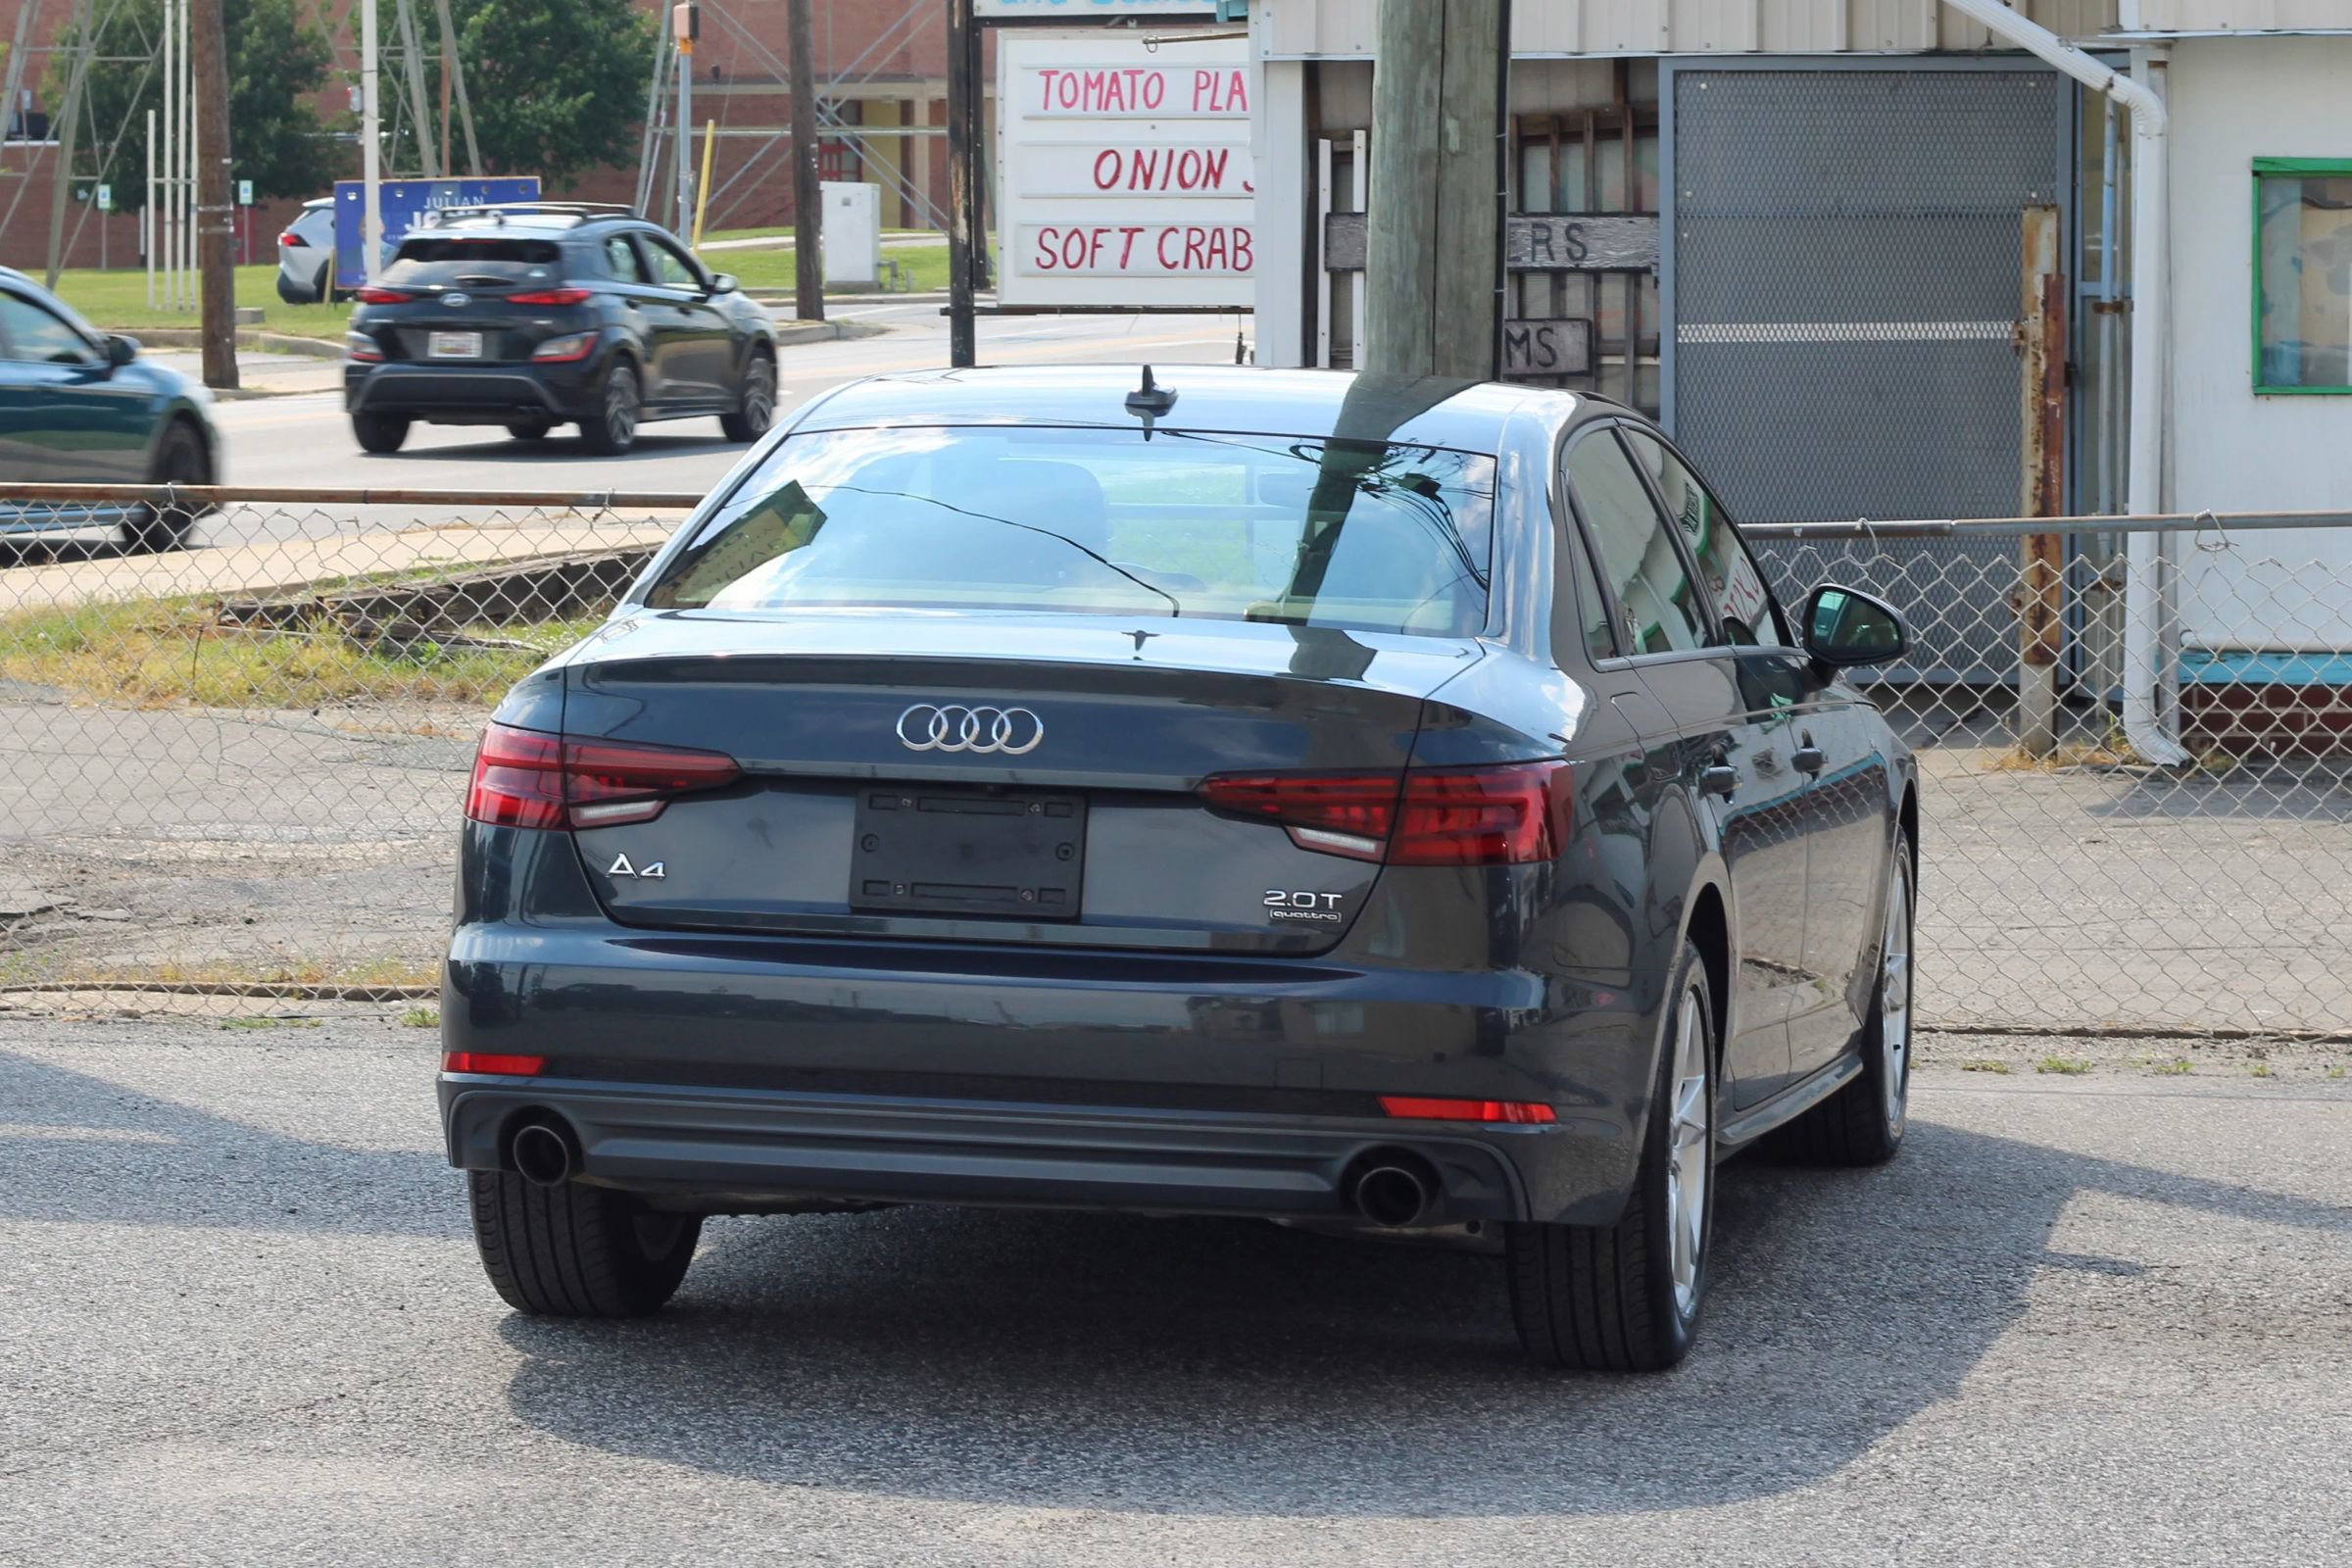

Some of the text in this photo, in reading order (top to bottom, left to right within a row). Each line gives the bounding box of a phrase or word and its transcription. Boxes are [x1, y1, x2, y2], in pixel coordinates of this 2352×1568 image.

[1038, 70, 1248, 112] TOMATO PLA
[1094, 148, 1229, 191] ONION
[422, 195, 485, 210] JULIAN
[1035, 226, 1254, 271] SOFT CRAB
[606, 853, 666, 879] A4
[1263, 889, 1344, 909] 2.0T
[1272, 909, 1340, 921] quattro
